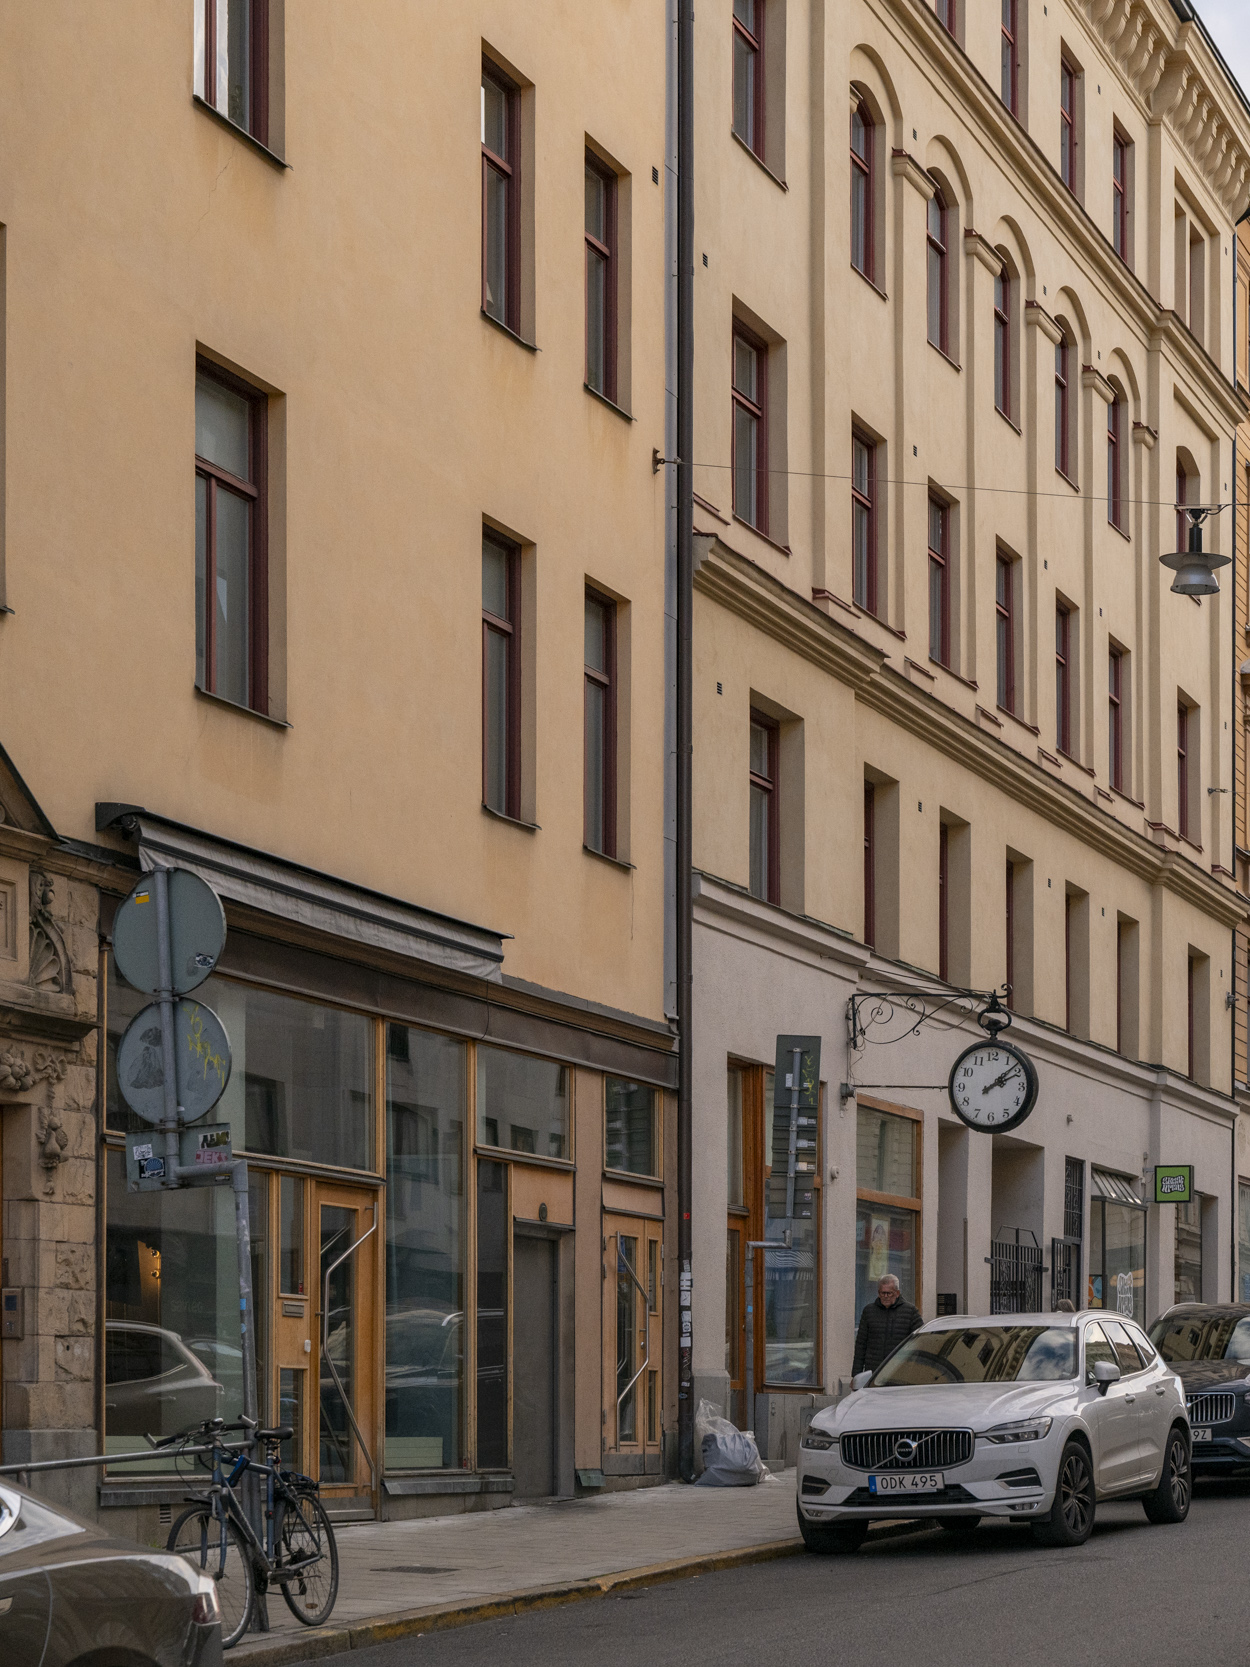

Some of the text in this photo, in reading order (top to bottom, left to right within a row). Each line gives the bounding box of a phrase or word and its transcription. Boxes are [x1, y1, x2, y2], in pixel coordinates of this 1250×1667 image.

[973, 1056, 984, 1066] 11
[987, 1051, 999, 1061] 12
[1005, 1056, 1010, 1066] 1
[962, 1067, 973, 1077] 10
[1014, 1068, 1021, 1077] 2
[958, 1082, 965, 1092] 9
[1018, 1082, 1025, 1091] 3
[962, 1096, 969, 1106] 8
[1014, 1096, 1020, 1106] 4
[974, 1108, 981, 1118] 7
[987, 1112, 994, 1122] 6
[1002, 1109, 1009, 1118] 5
[880, 1475, 938, 1490] ODK 495
